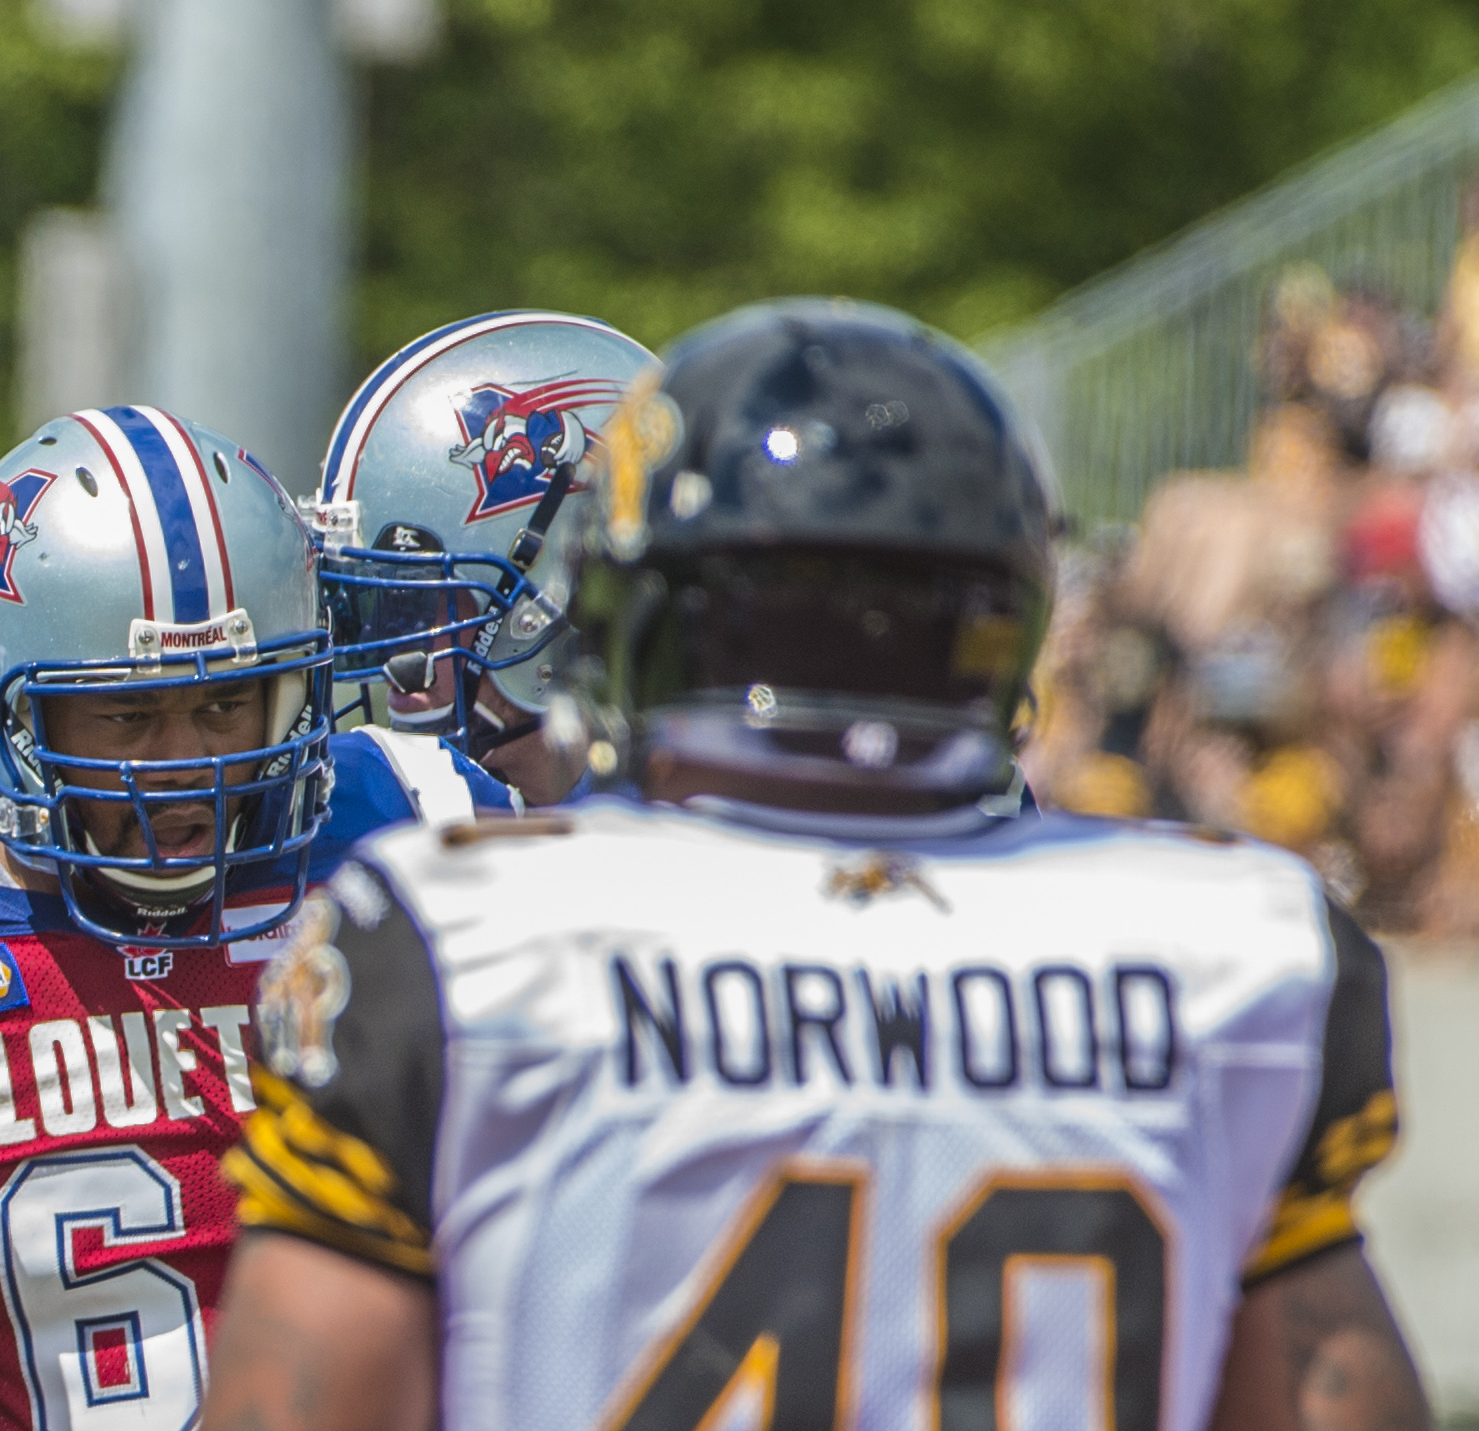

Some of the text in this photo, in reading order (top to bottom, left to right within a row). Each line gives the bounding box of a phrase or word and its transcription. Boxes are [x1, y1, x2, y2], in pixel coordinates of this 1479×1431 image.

[161, 626, 227, 648] MONTRÉAL
[127, 954, 173, 977] LCF
[611, 952, 1179, 1092] NORWOOD
